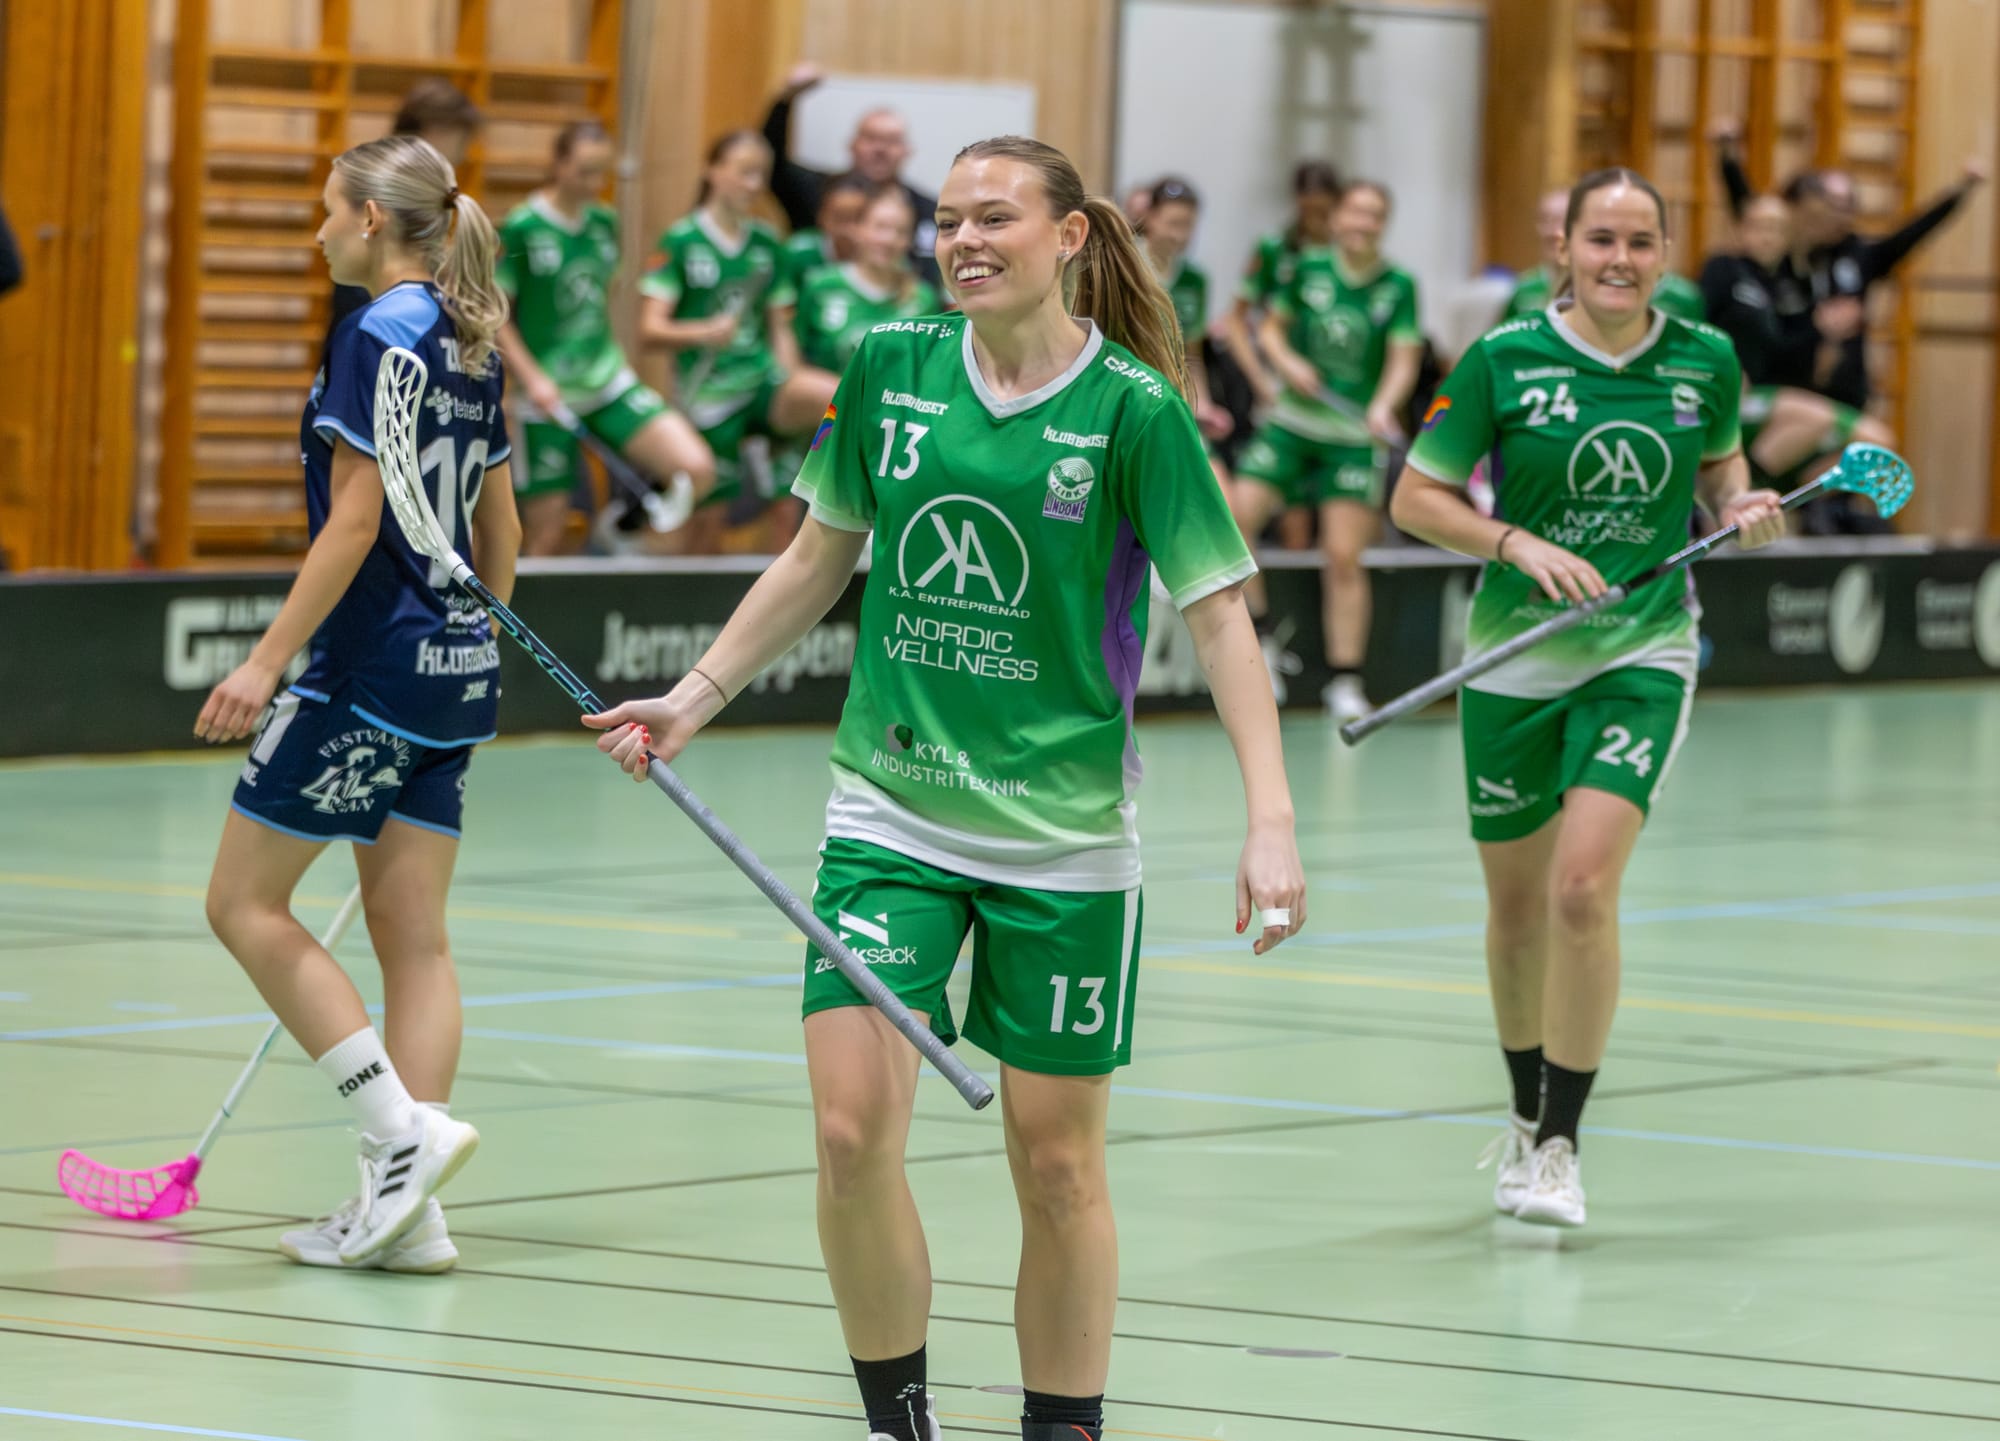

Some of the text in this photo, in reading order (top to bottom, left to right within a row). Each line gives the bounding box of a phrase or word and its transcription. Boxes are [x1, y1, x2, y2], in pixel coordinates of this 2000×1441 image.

[871, 321, 940, 336] CRAFT
[1103, 355, 1156, 384] CRAFT
[1519, 383, 1579, 427] 24
[877, 418, 930, 481] 13
[913, 512, 1006, 603] KA
[888, 586, 1031, 619] K.A. ENTREPRENAD
[895, 613, 1014, 654] NORDIC
[915, 742, 971, 769] KYL &
[1594, 725, 1653, 778] 24
[871, 748, 1031, 798] INDUSTRITEKNIK
[814, 946, 917, 975] zeksack
[1049, 975, 1106, 1036] 13
[337, 1061, 386, 1098] ZONE
